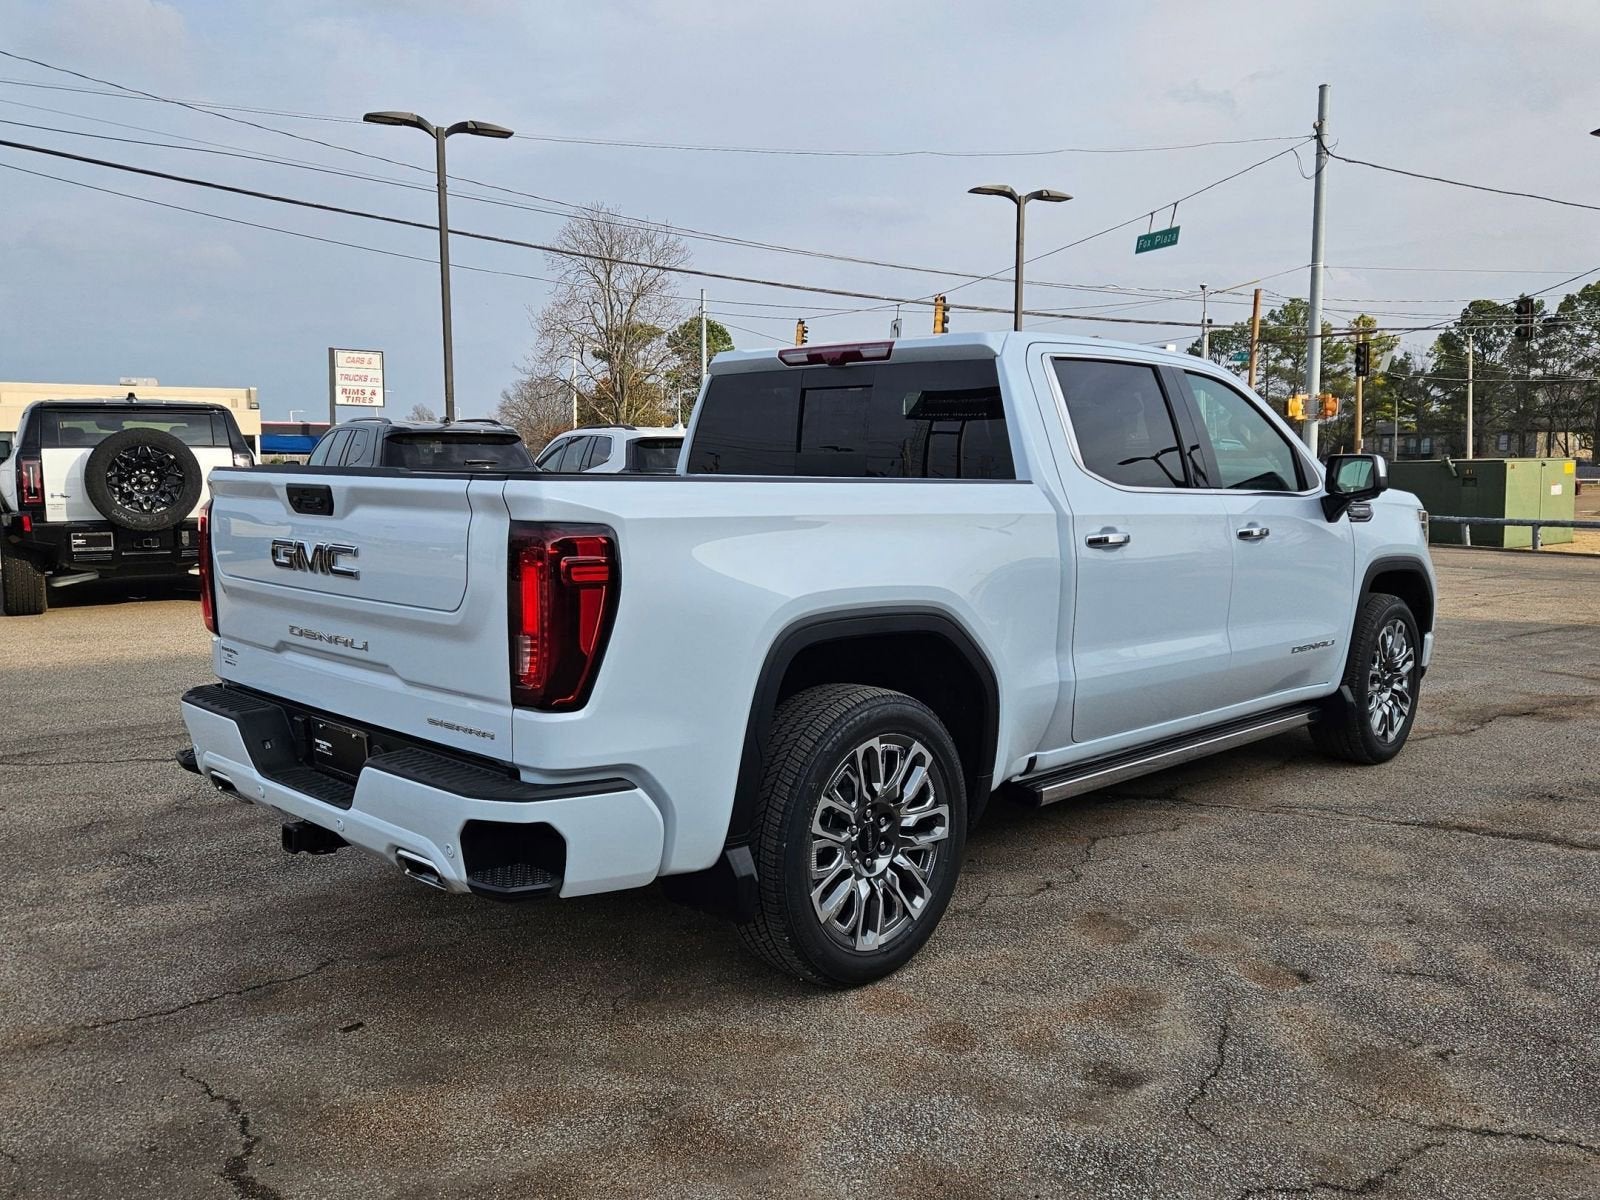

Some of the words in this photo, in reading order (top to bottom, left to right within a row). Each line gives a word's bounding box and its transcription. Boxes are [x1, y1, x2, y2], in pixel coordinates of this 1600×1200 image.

[1138, 238, 1151, 249] Fox
[1154, 233, 1177, 246] Plaza
[345, 356, 366, 365] CARS
[339, 373, 369, 382] TRUCKS
[341, 388, 366, 396] RIMS
[345, 396, 374, 404] TIRES
[271, 537, 361, 581] GMC
[288, 624, 369, 652] DENALI
[1291, 639, 1336, 654] DENALI
[426, 717, 496, 741] SIERRA
